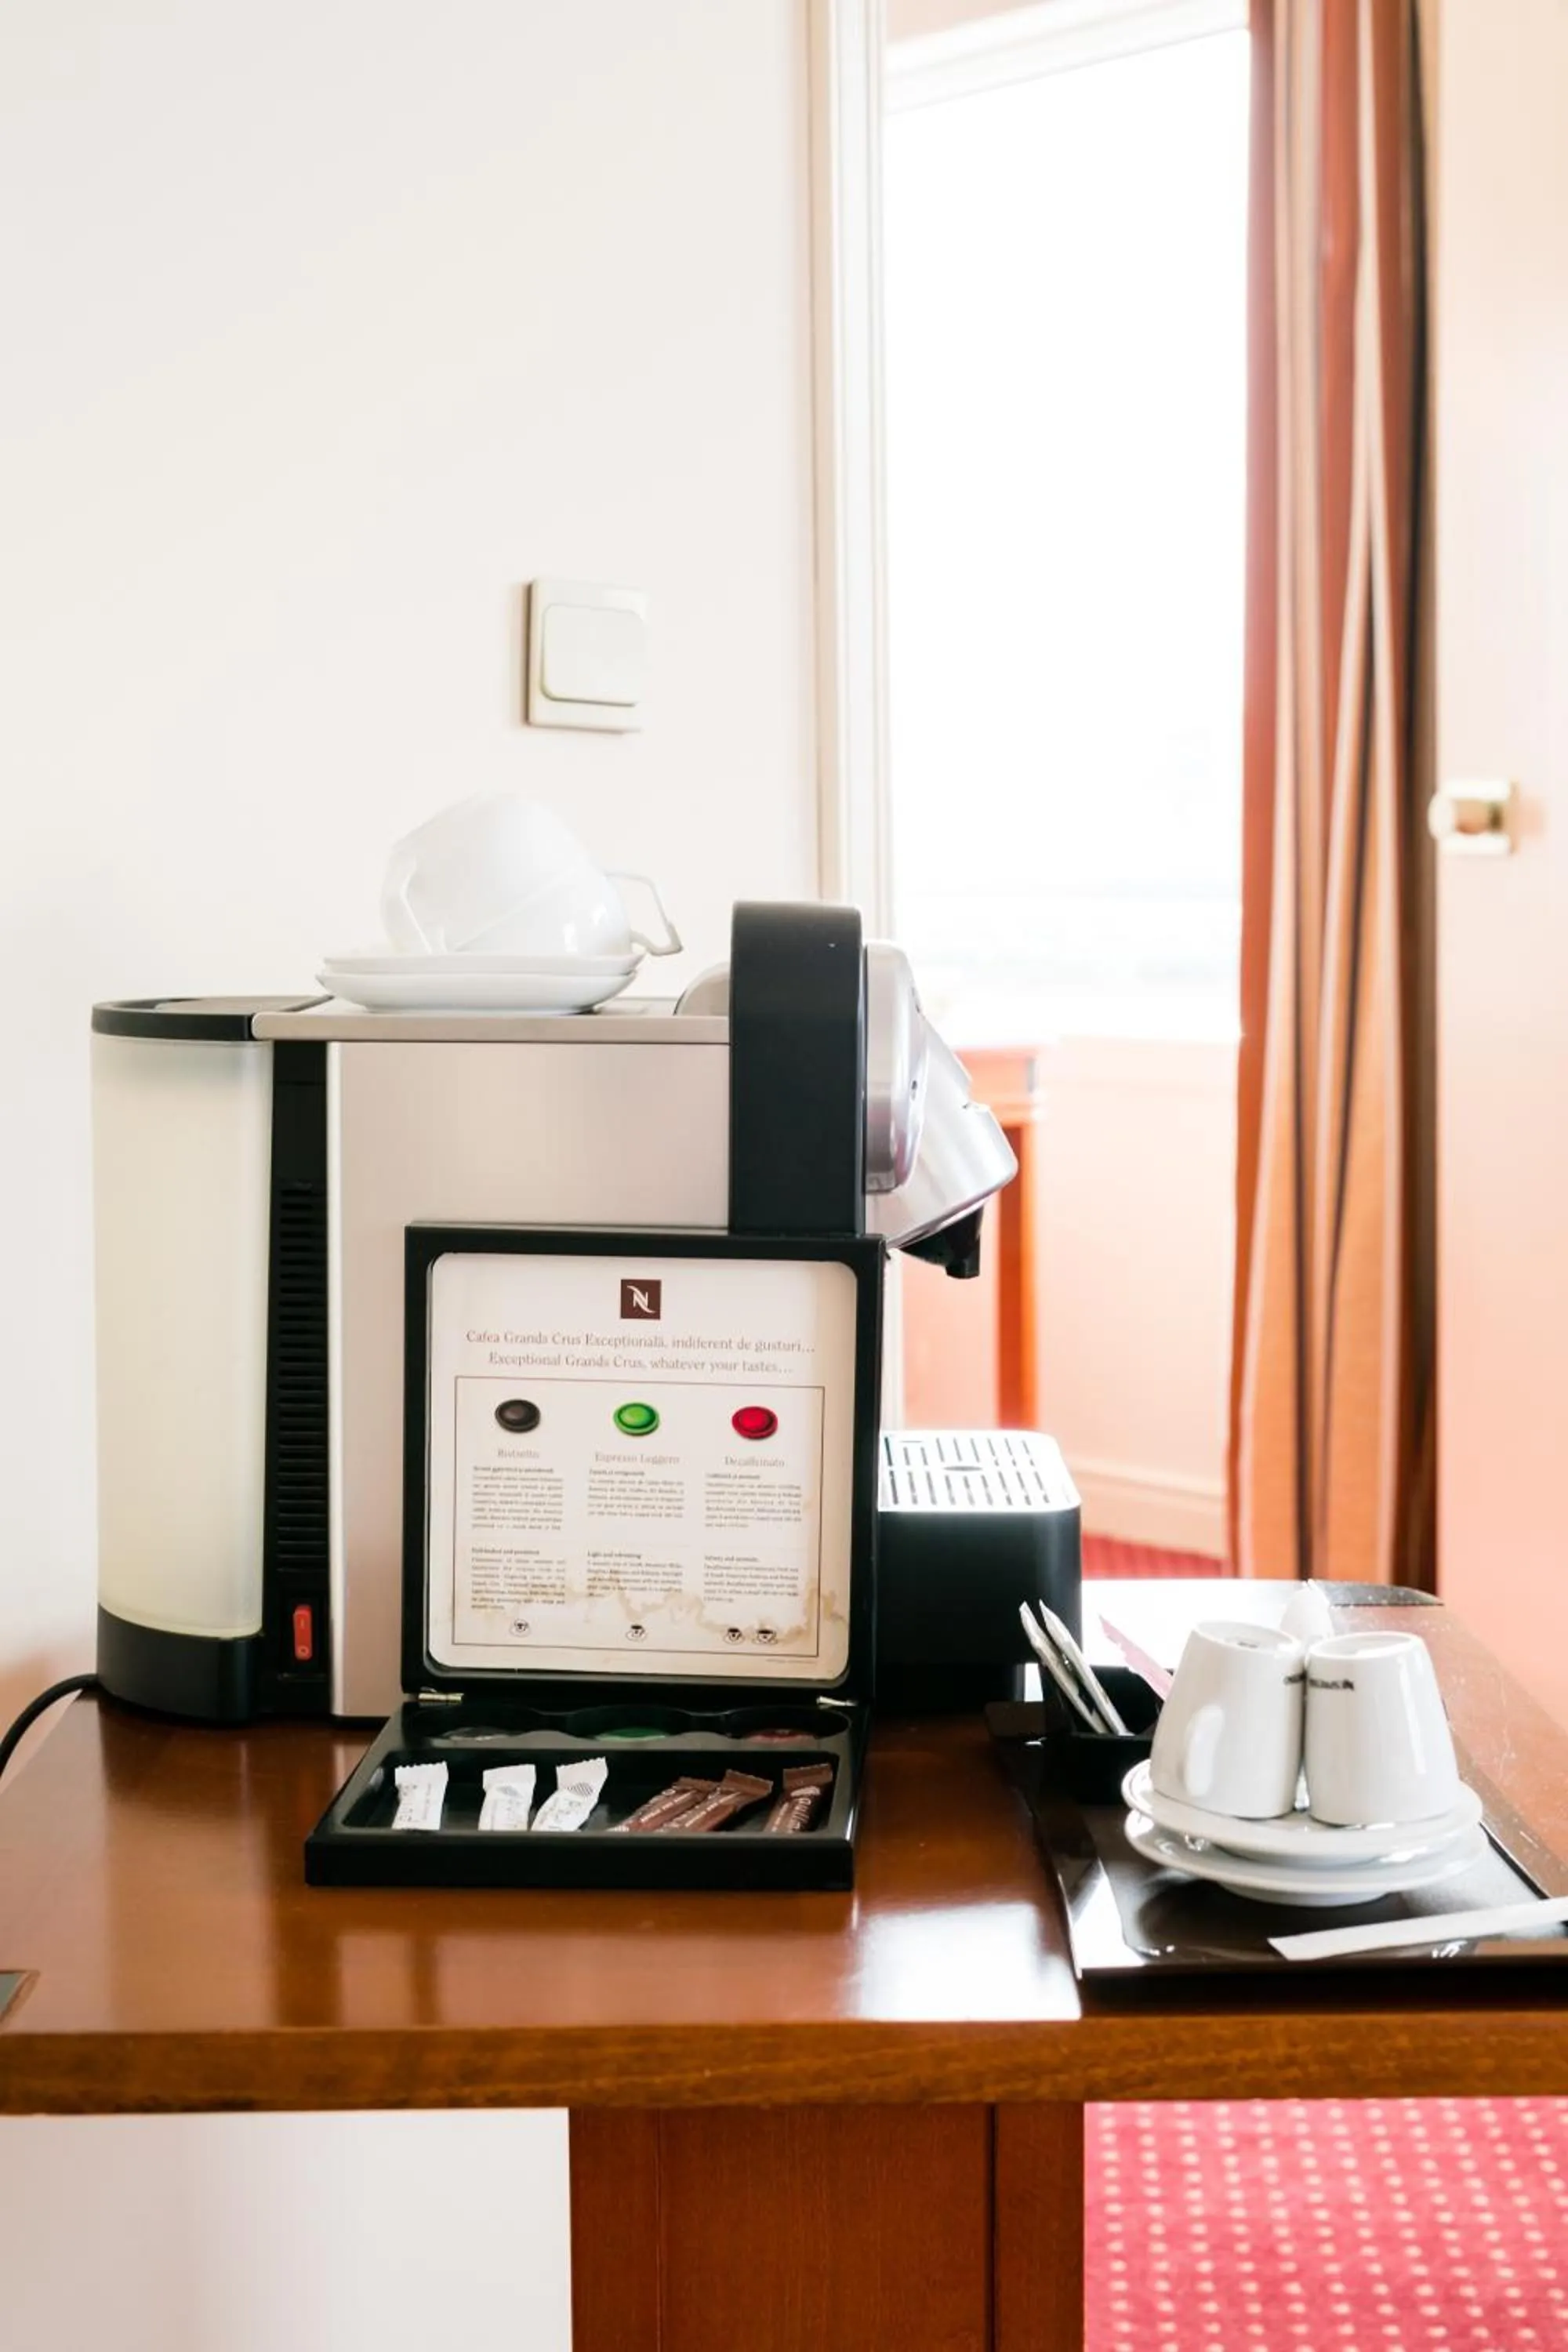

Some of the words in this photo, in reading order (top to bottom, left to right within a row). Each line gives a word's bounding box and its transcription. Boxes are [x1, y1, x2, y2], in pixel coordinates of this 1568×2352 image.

[466, 1330, 500, 1344] Cafea
[504, 1332, 548, 1345] Grands
[552, 1333, 581, 1345] Crus
[672, 1336, 733, 1350] indiferent
[737, 1336, 751, 1350] de
[488, 1351, 561, 1367] Exceptional
[565, 1352, 609, 1367] Grands
[650, 1356, 706, 1371] whatever
[709, 1359, 739, 1374] your
